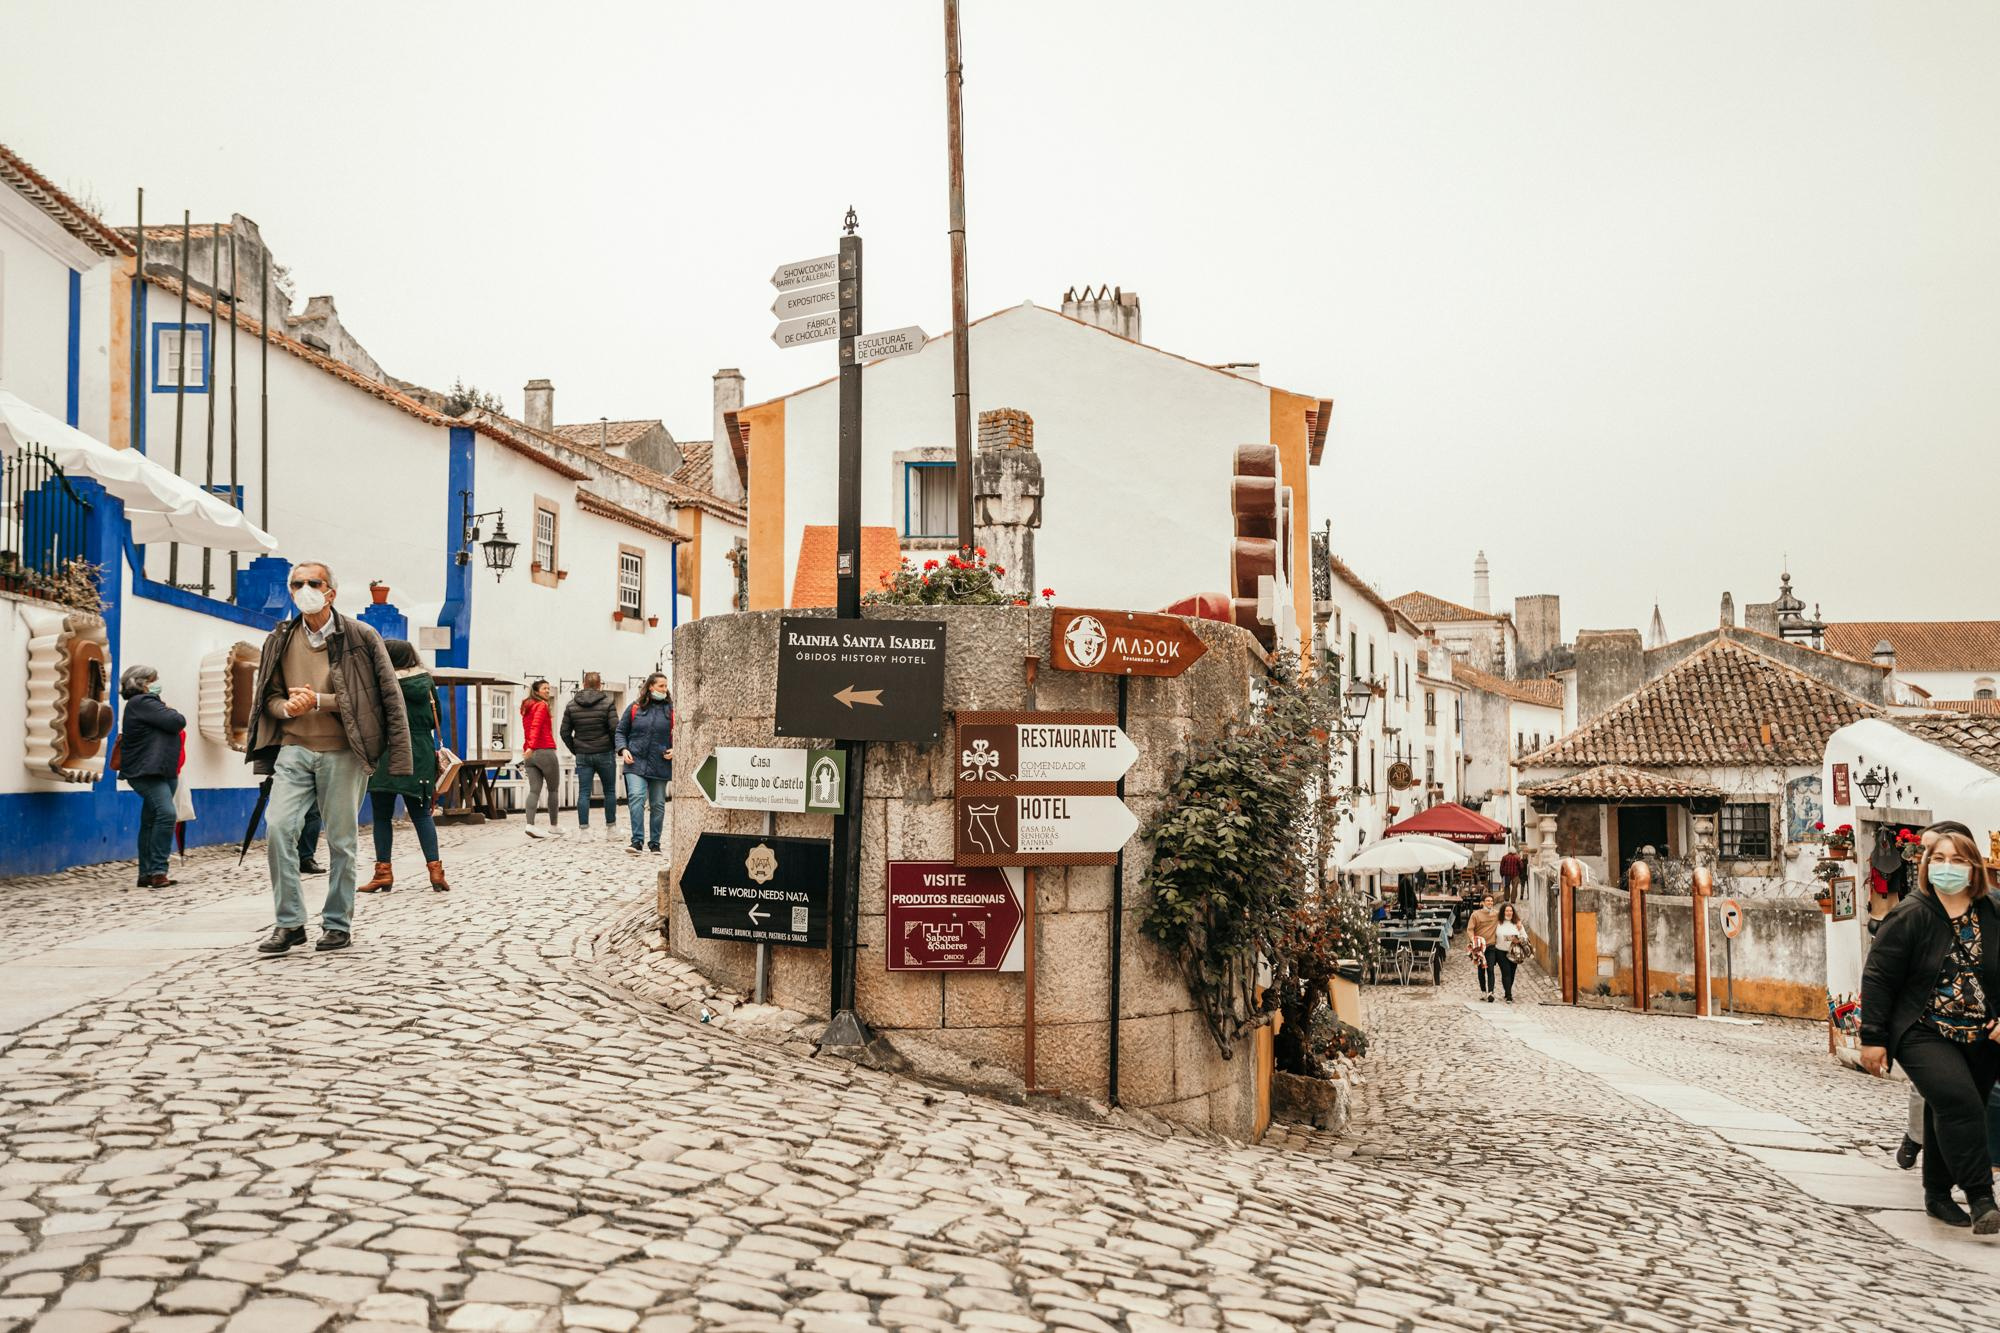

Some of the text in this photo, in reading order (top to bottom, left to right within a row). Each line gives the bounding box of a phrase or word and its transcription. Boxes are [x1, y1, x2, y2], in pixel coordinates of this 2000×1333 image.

[783, 261, 836, 279] SHOWCOOKING
[776, 278, 796, 288] BARRY
[801, 269, 835, 283] CALLEBAUT
[788, 292, 836, 308] EXPOSITORES
[784, 326, 837, 344] DE CHOCOLATE
[858, 333, 905, 349] ESCULTURAS
[858, 341, 913, 359] DE CHOCOLATE
[1112, 637, 1180, 658] MADOK
[795, 651, 927, 665] ÓBIDOS HISTORY HOTEL
[1021, 728, 1116, 748] RESTAURANTE
[750, 755, 771, 768] Casa
[1020, 761, 1086, 770] COMENDADOR
[731, 774, 759, 790] Thiago
[761, 776, 771, 788] do
[772, 776, 804, 790] Castelo
[1021, 770, 1048, 778] SILVA
[1021, 798, 1070, 819] HOTEL
[1020, 832, 1060, 840] SENHORAS
[923, 874, 967, 887] VISITE
[712, 885, 810, 903] THE WORLD NEEDS NATA
[892, 894, 1006, 904] PRODUTOS REGIONAIS
[768, 932, 787, 941] PASTRIES
[791, 934, 808, 942] SNACKS
[926, 932, 960, 942] Sabores
